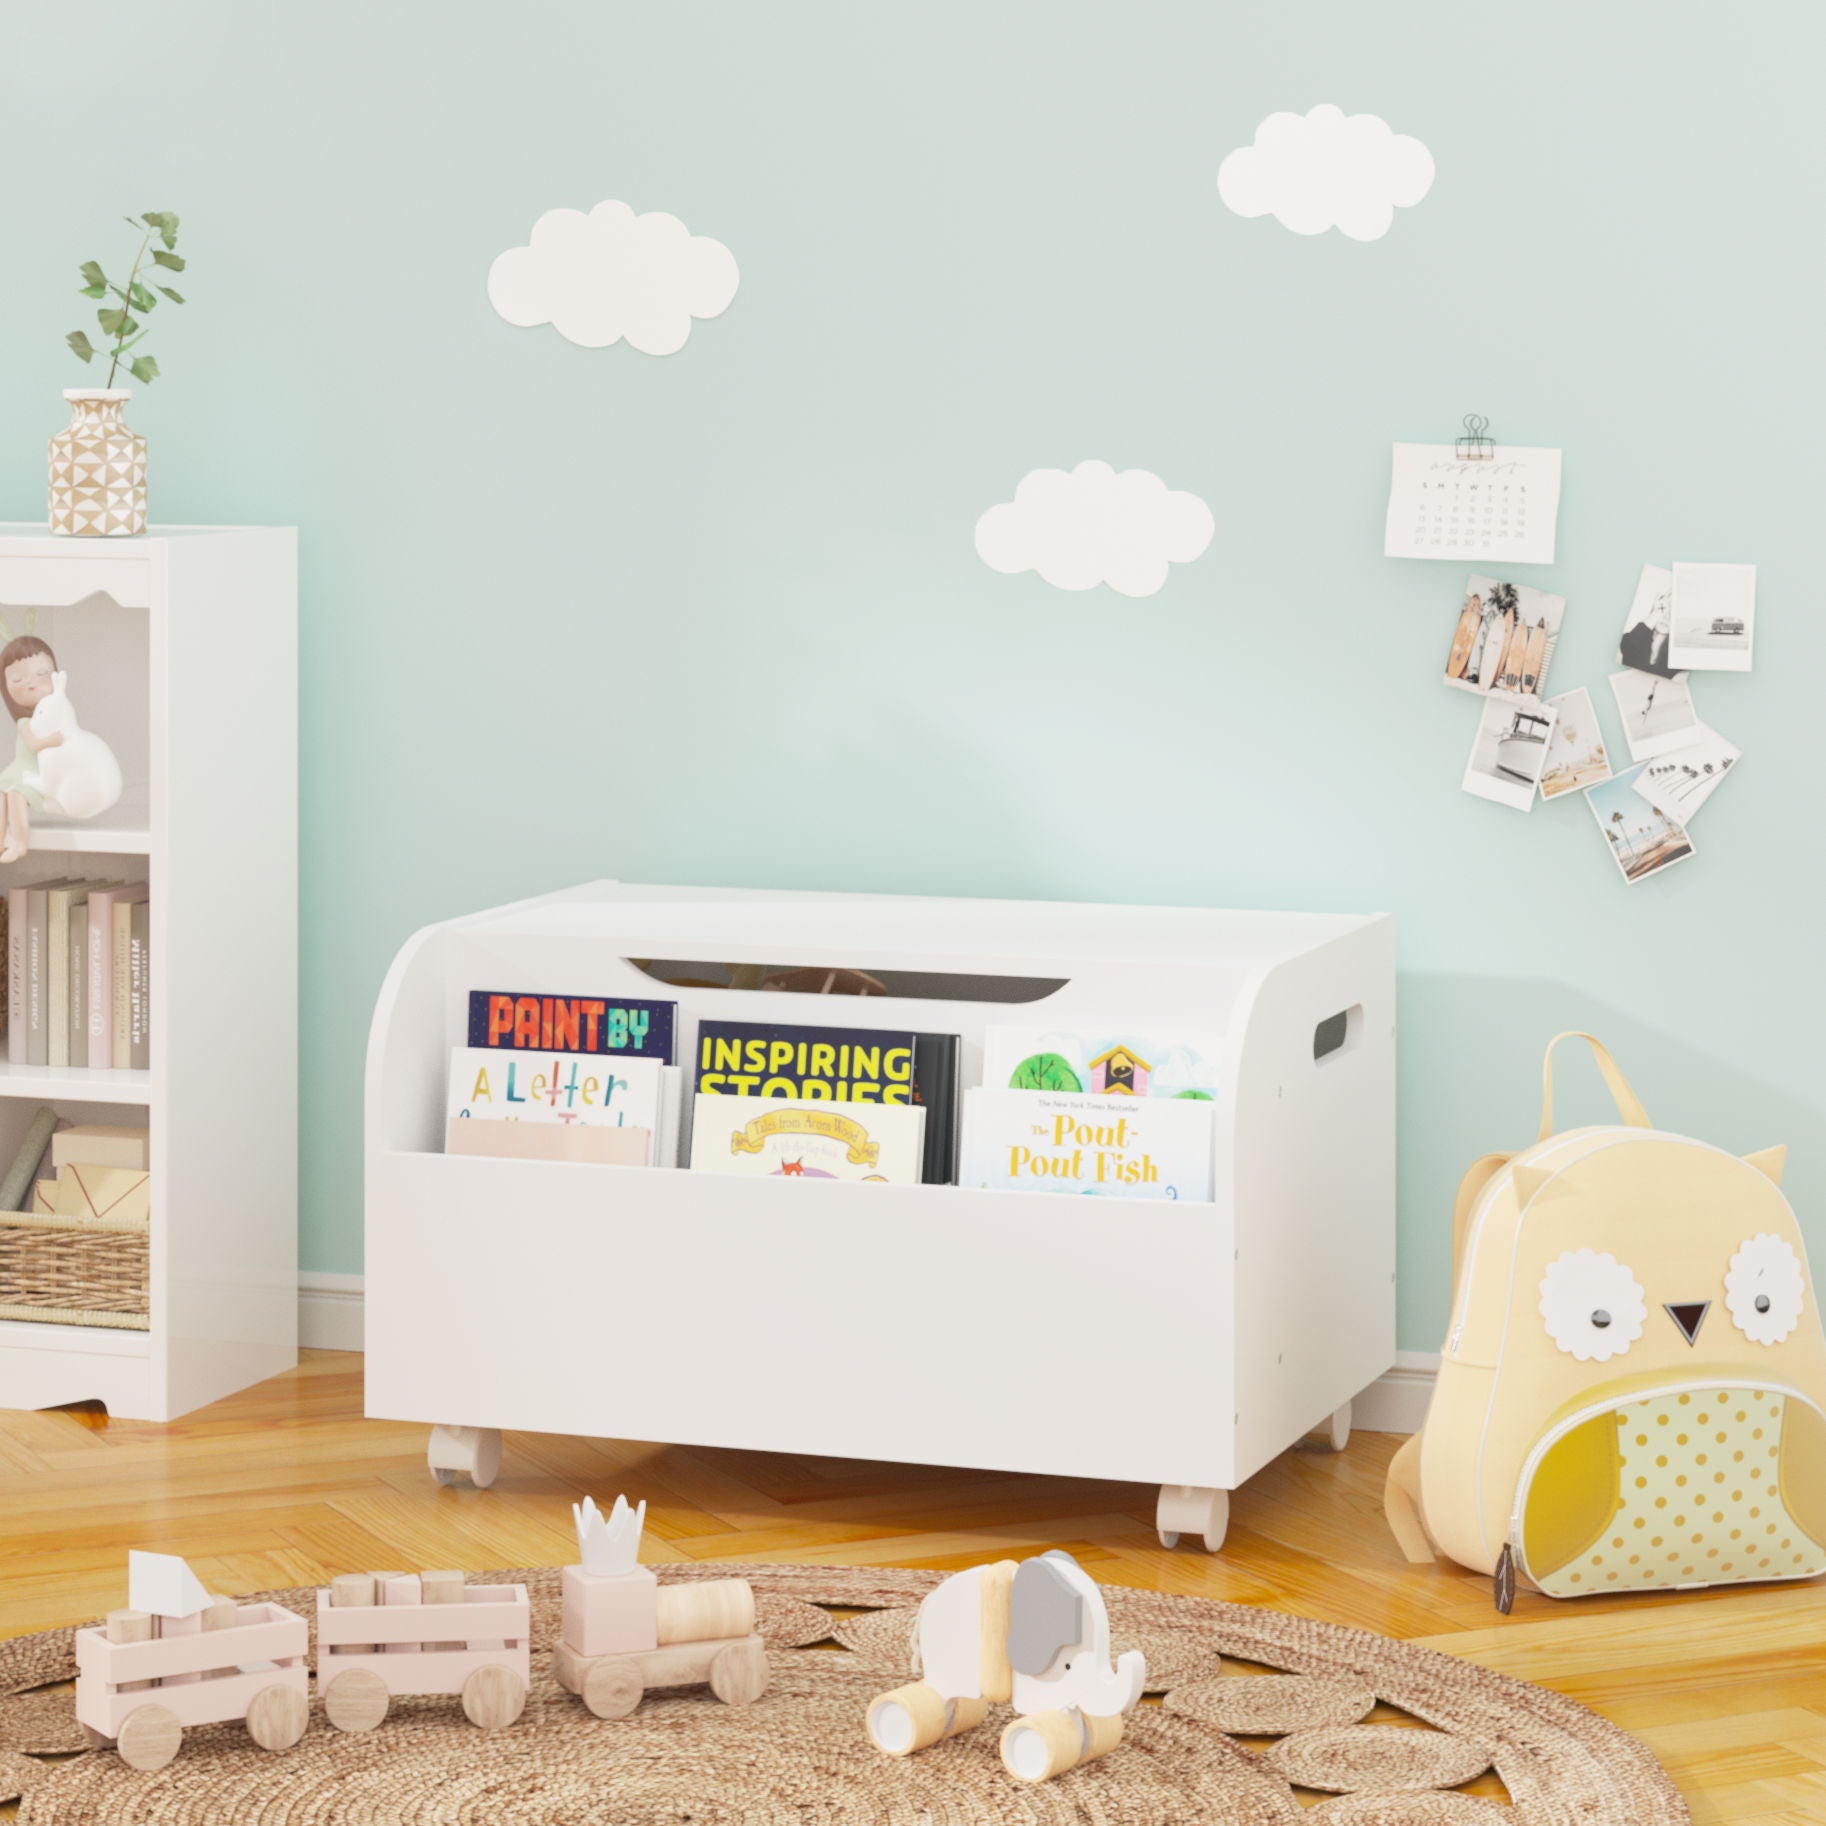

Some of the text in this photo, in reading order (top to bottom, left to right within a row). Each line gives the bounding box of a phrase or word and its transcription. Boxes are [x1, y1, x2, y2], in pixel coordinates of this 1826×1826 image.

[488, 995, 649, 1052] PAINT BY
[701, 1037, 912, 1082] INSPIRING
[471, 1060, 629, 1108] A Letter
[1031, 1114, 1139, 1149] The Pout-
[1006, 1145, 1161, 1185] Pout Fish
